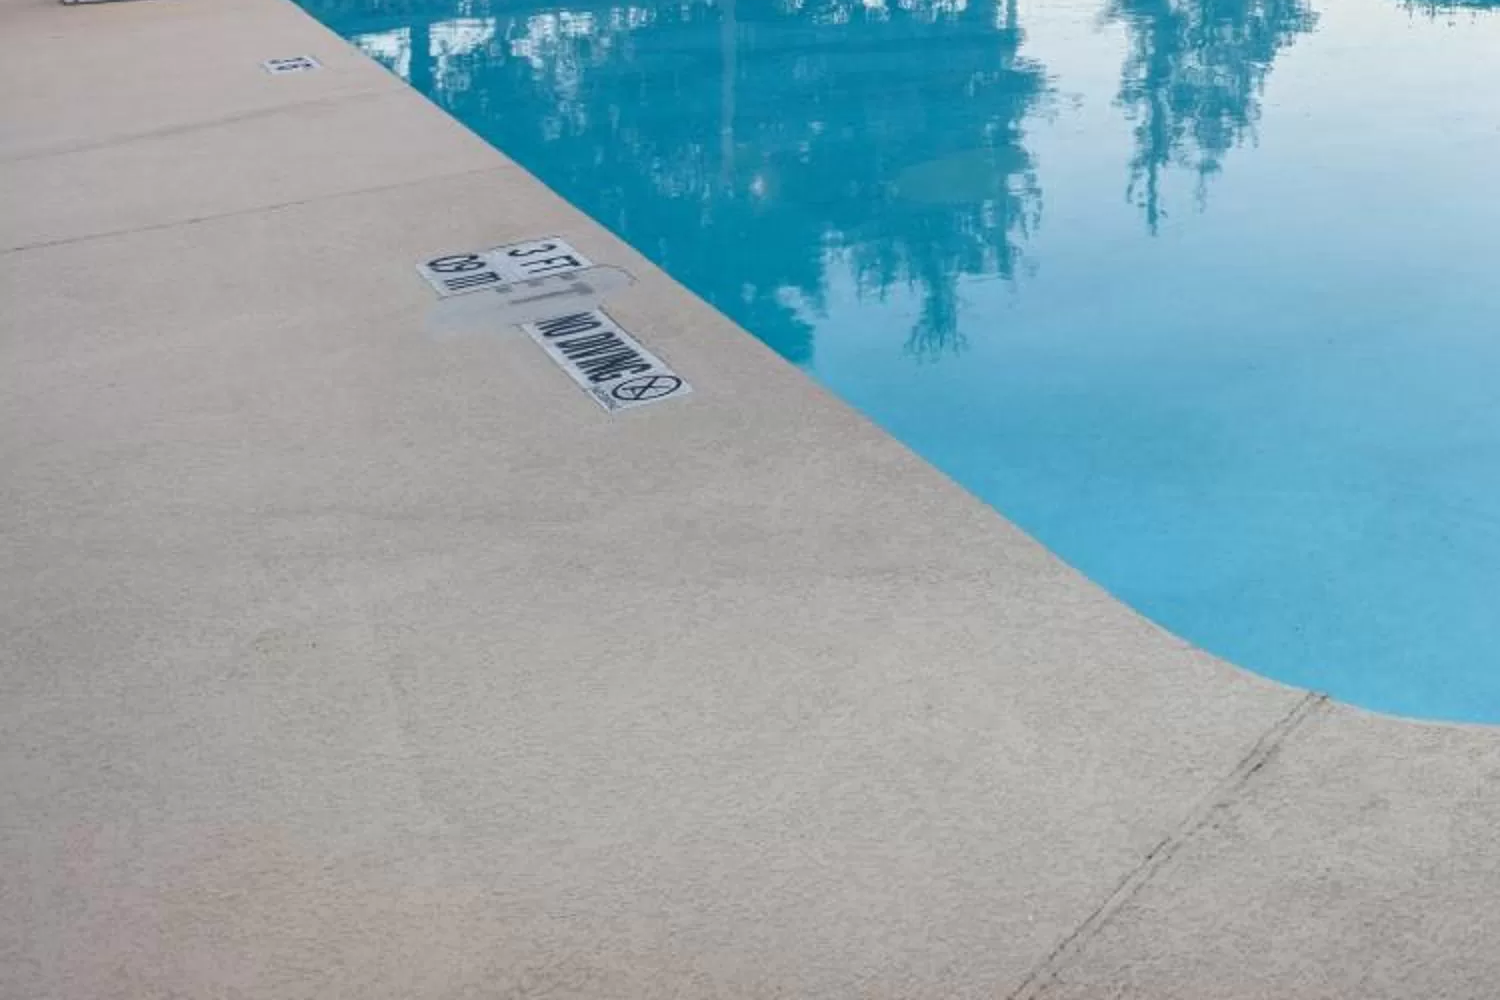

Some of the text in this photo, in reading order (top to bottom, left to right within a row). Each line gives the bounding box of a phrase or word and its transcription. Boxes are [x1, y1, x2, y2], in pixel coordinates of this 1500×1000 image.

[508, 243, 581, 274] 3 FT
[539, 311, 652, 382] NO DIVING
